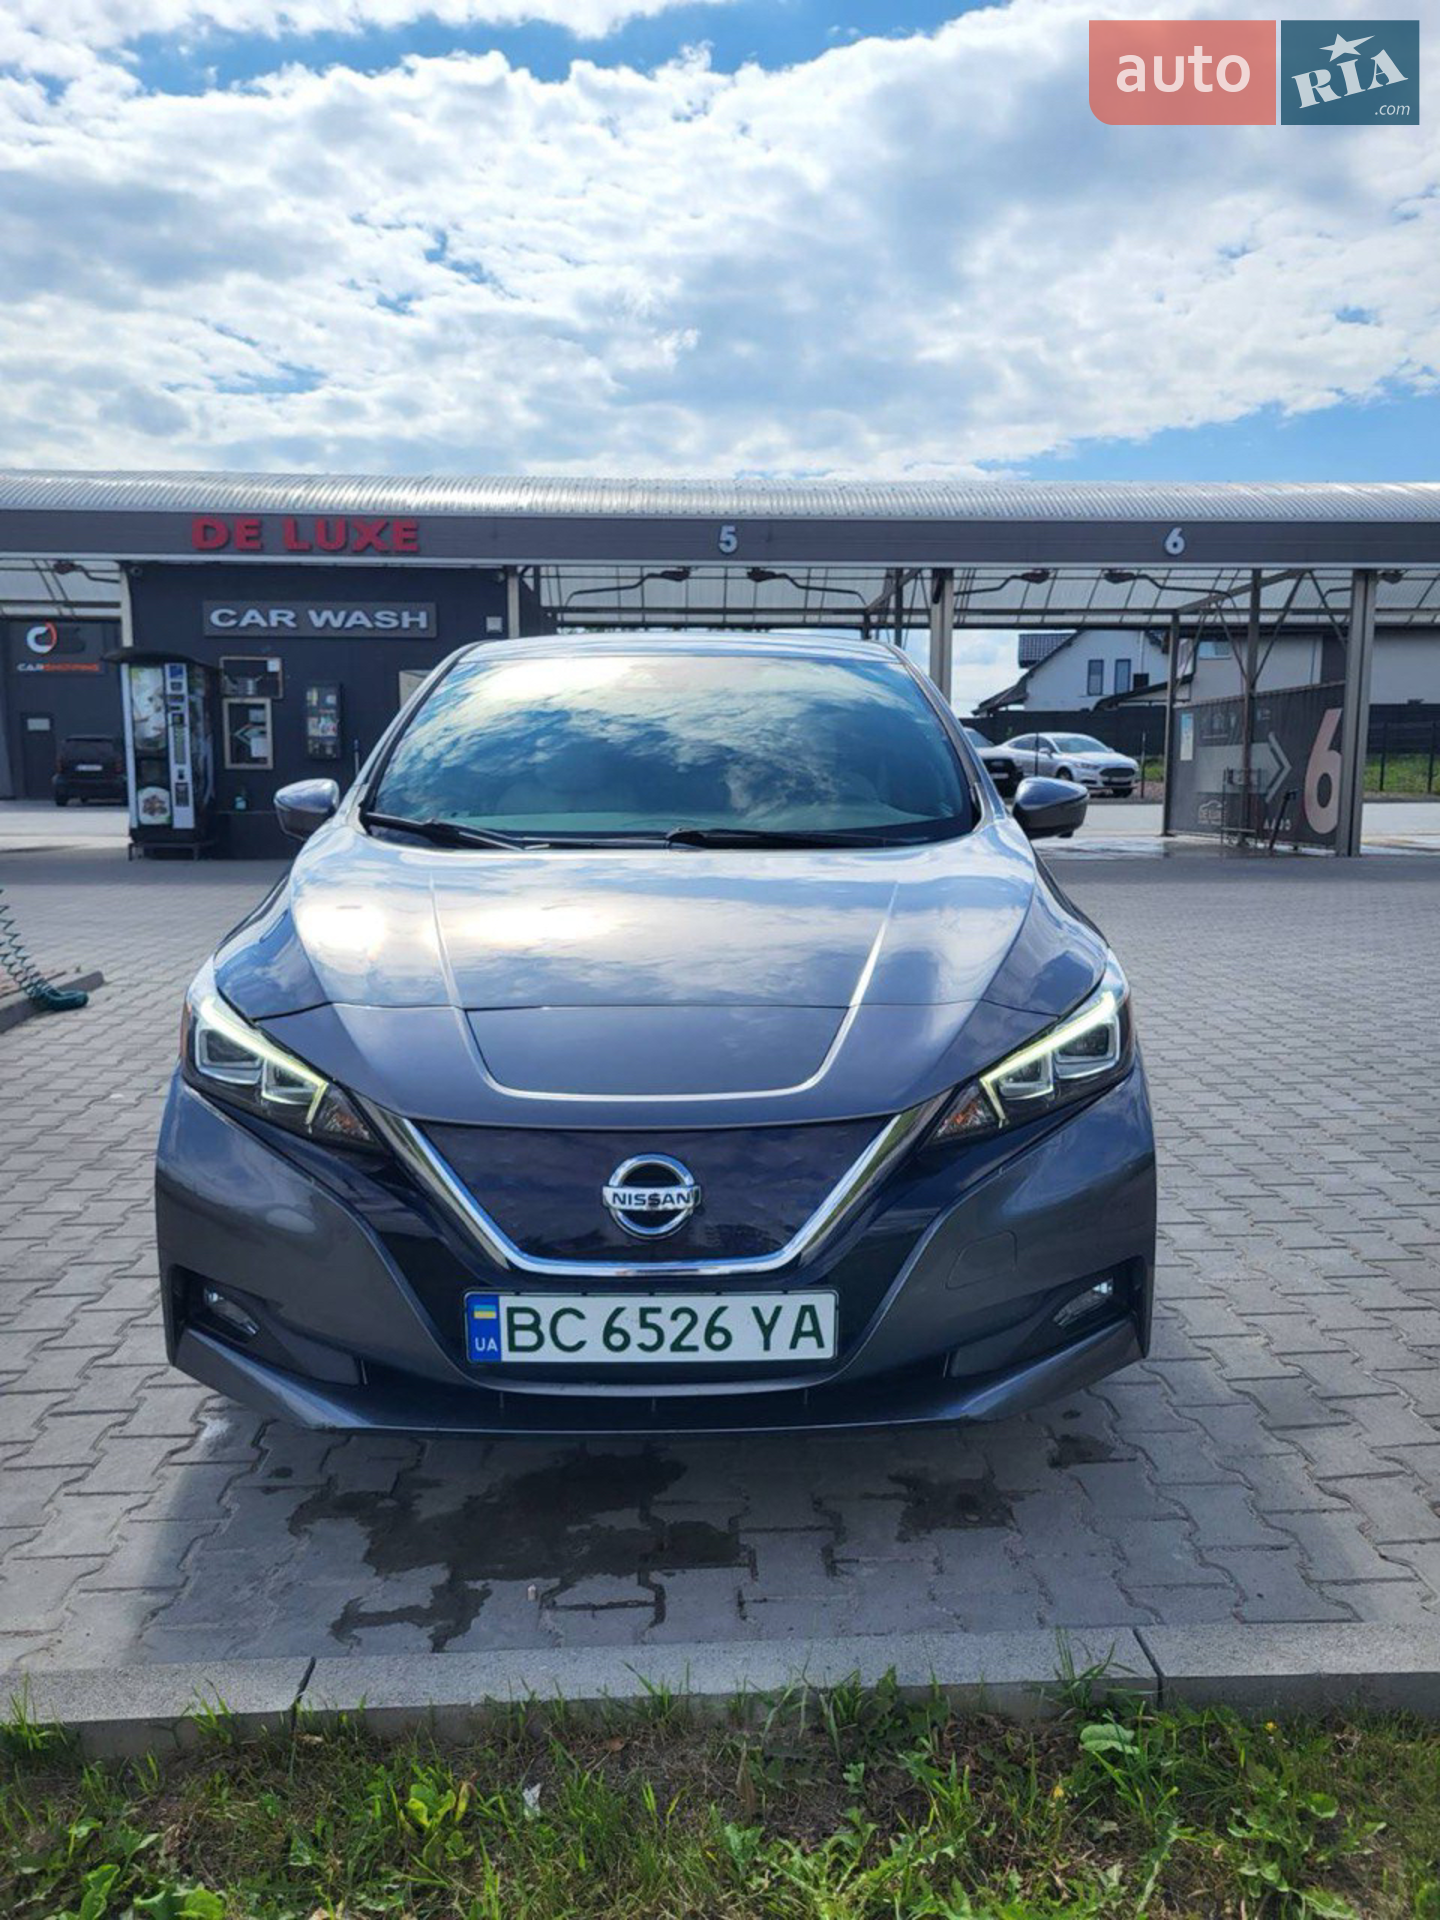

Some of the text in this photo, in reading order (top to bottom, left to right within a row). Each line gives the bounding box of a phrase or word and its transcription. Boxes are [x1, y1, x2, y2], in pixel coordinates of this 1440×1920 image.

[191, 516, 419, 552] DE LUXE
[718, 525, 738, 553] 5
[1163, 527, 1187, 556] 6
[209, 608, 428, 629] CAR WASH
[1303, 707, 1343, 835] 6
[612, 1192, 692, 1208] NISSAN
[474, 1304, 826, 1353] UA BC 6526 YA
